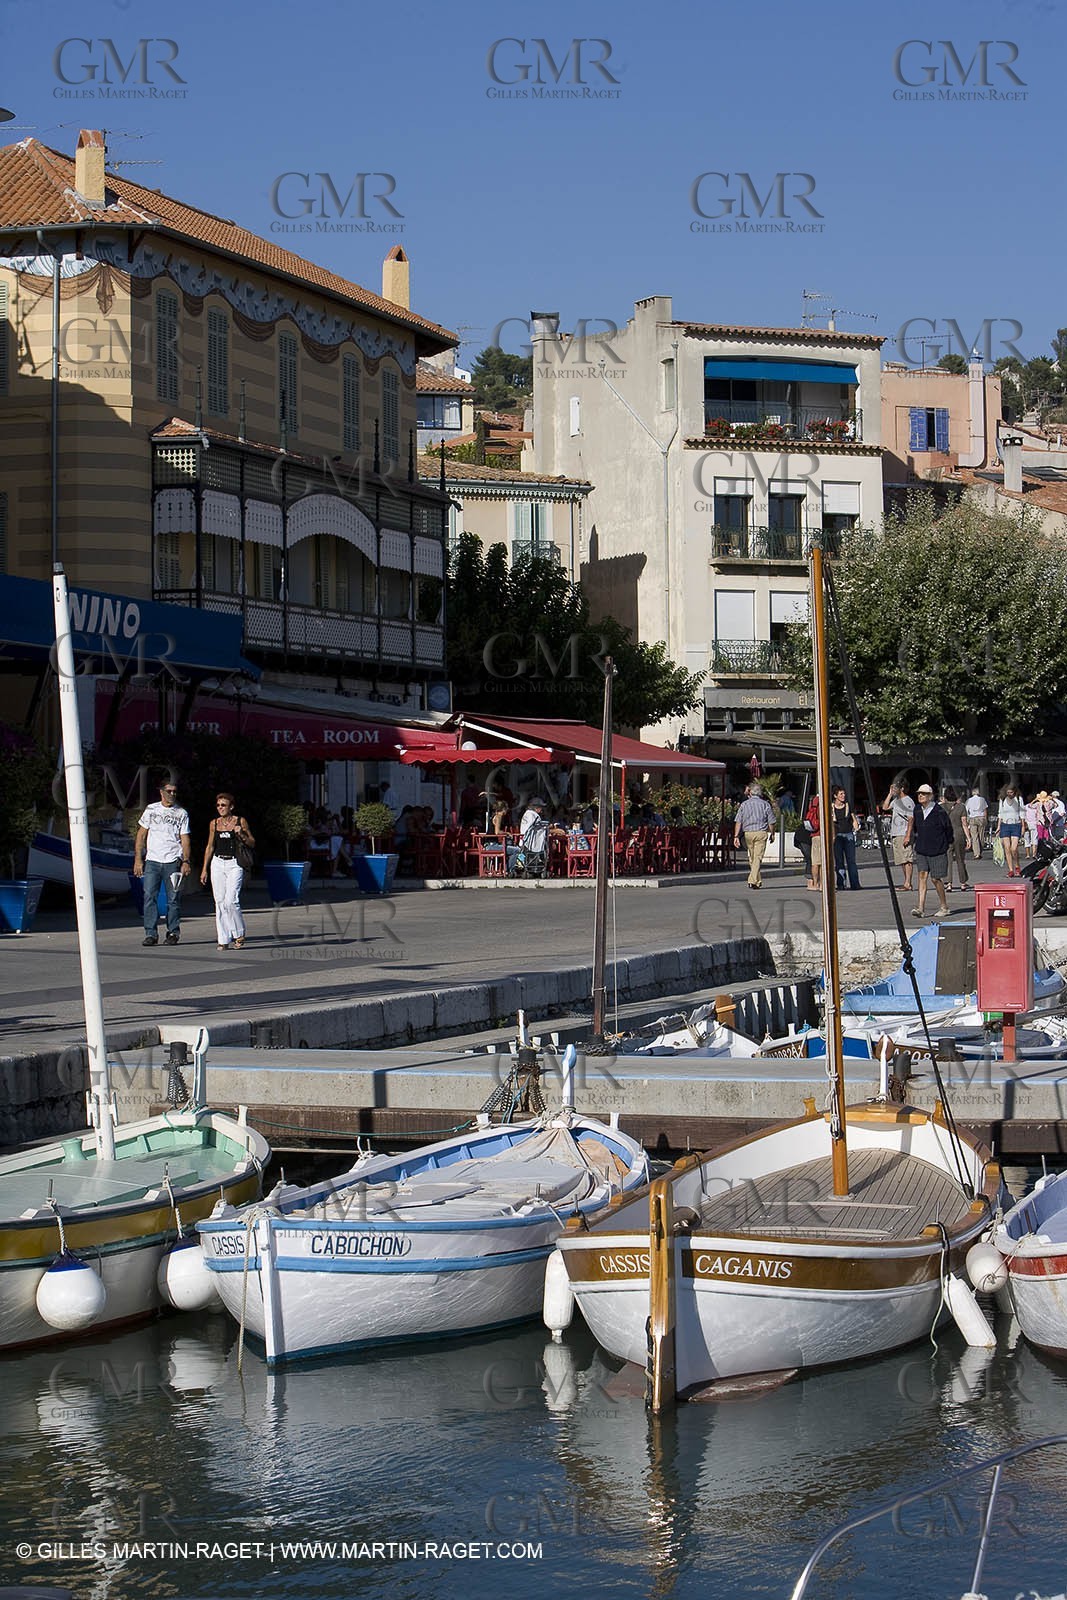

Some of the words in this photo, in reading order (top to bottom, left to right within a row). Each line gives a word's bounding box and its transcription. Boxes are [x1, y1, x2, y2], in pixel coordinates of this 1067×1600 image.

[69, 592, 140, 638] NINO
[741, 695, 780, 705] Restaurant
[270, 729, 306, 743] TEA
[323, 729, 380, 744] ROOM
[211, 1235, 245, 1255] CASSIS
[311, 1235, 404, 1256] CABOCHON
[599, 1253, 651, 1273] CASSIS
[695, 1254, 793, 1279] CAGANIS
